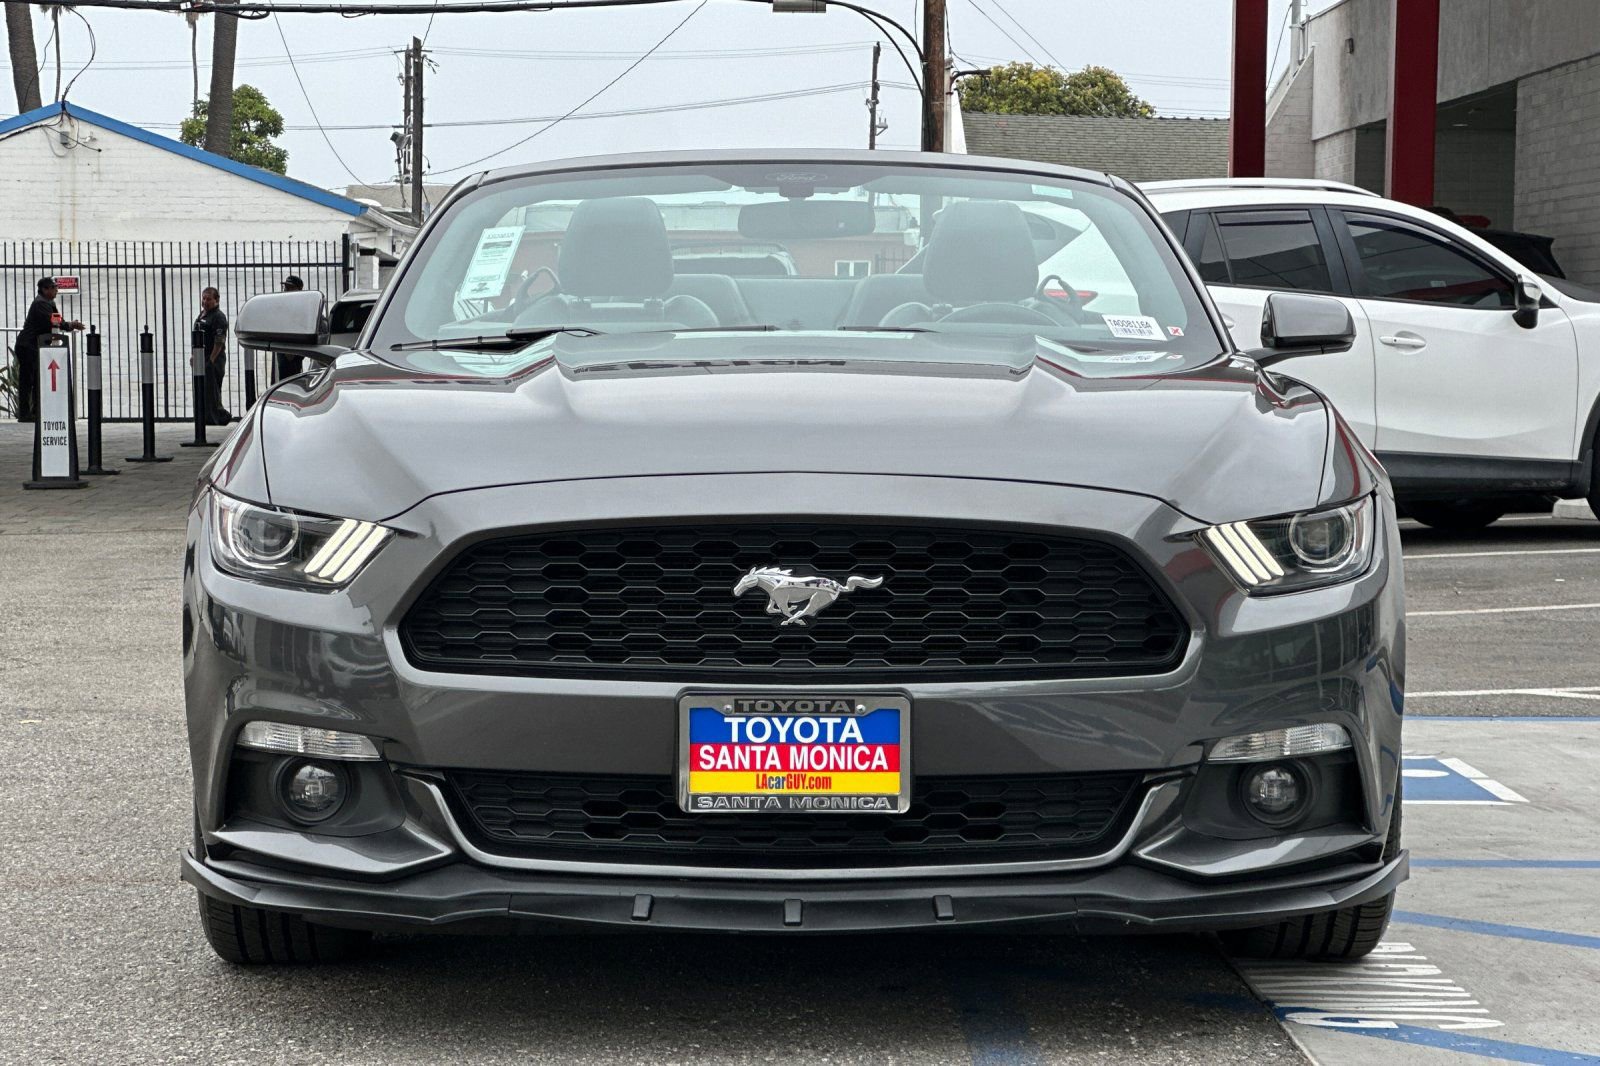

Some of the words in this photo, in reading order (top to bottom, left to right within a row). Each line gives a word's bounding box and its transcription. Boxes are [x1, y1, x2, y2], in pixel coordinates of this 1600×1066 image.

[43, 421, 67, 431] TOYOTA
[43, 436, 67, 446] SERVICE
[738, 699, 850, 713] TOYOTA
[724, 716, 864, 743] TOYOTA
[699, 745, 782, 770] SANTA
[789, 745, 889, 770] MONICA
[755, 773, 832, 790] LAcarGUY.com
[697, 796, 783, 809] SANTA
[789, 796, 892, 809] MONICA
